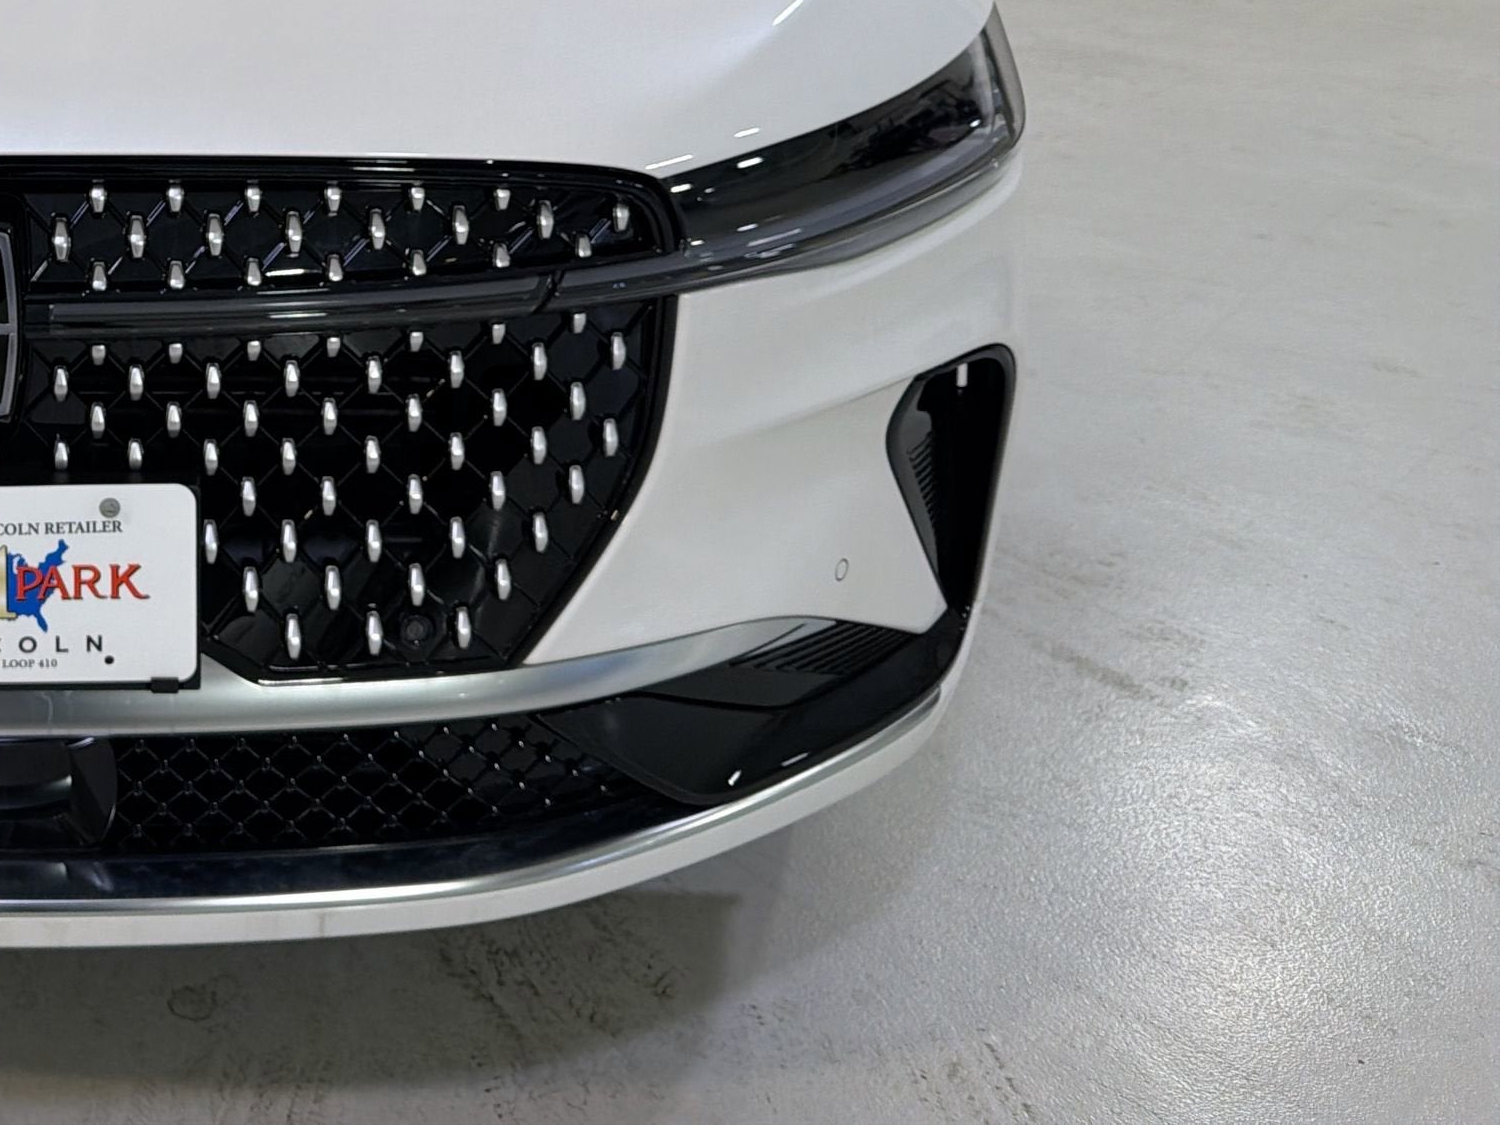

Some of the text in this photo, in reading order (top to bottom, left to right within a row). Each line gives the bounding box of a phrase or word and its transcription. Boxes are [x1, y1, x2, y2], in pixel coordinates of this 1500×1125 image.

[44, 520, 123, 535] RETAILER
[15, 563, 150, 602] PARK
[2, 659, 36, 669] LOOP
[38, 658, 58, 668] 410
